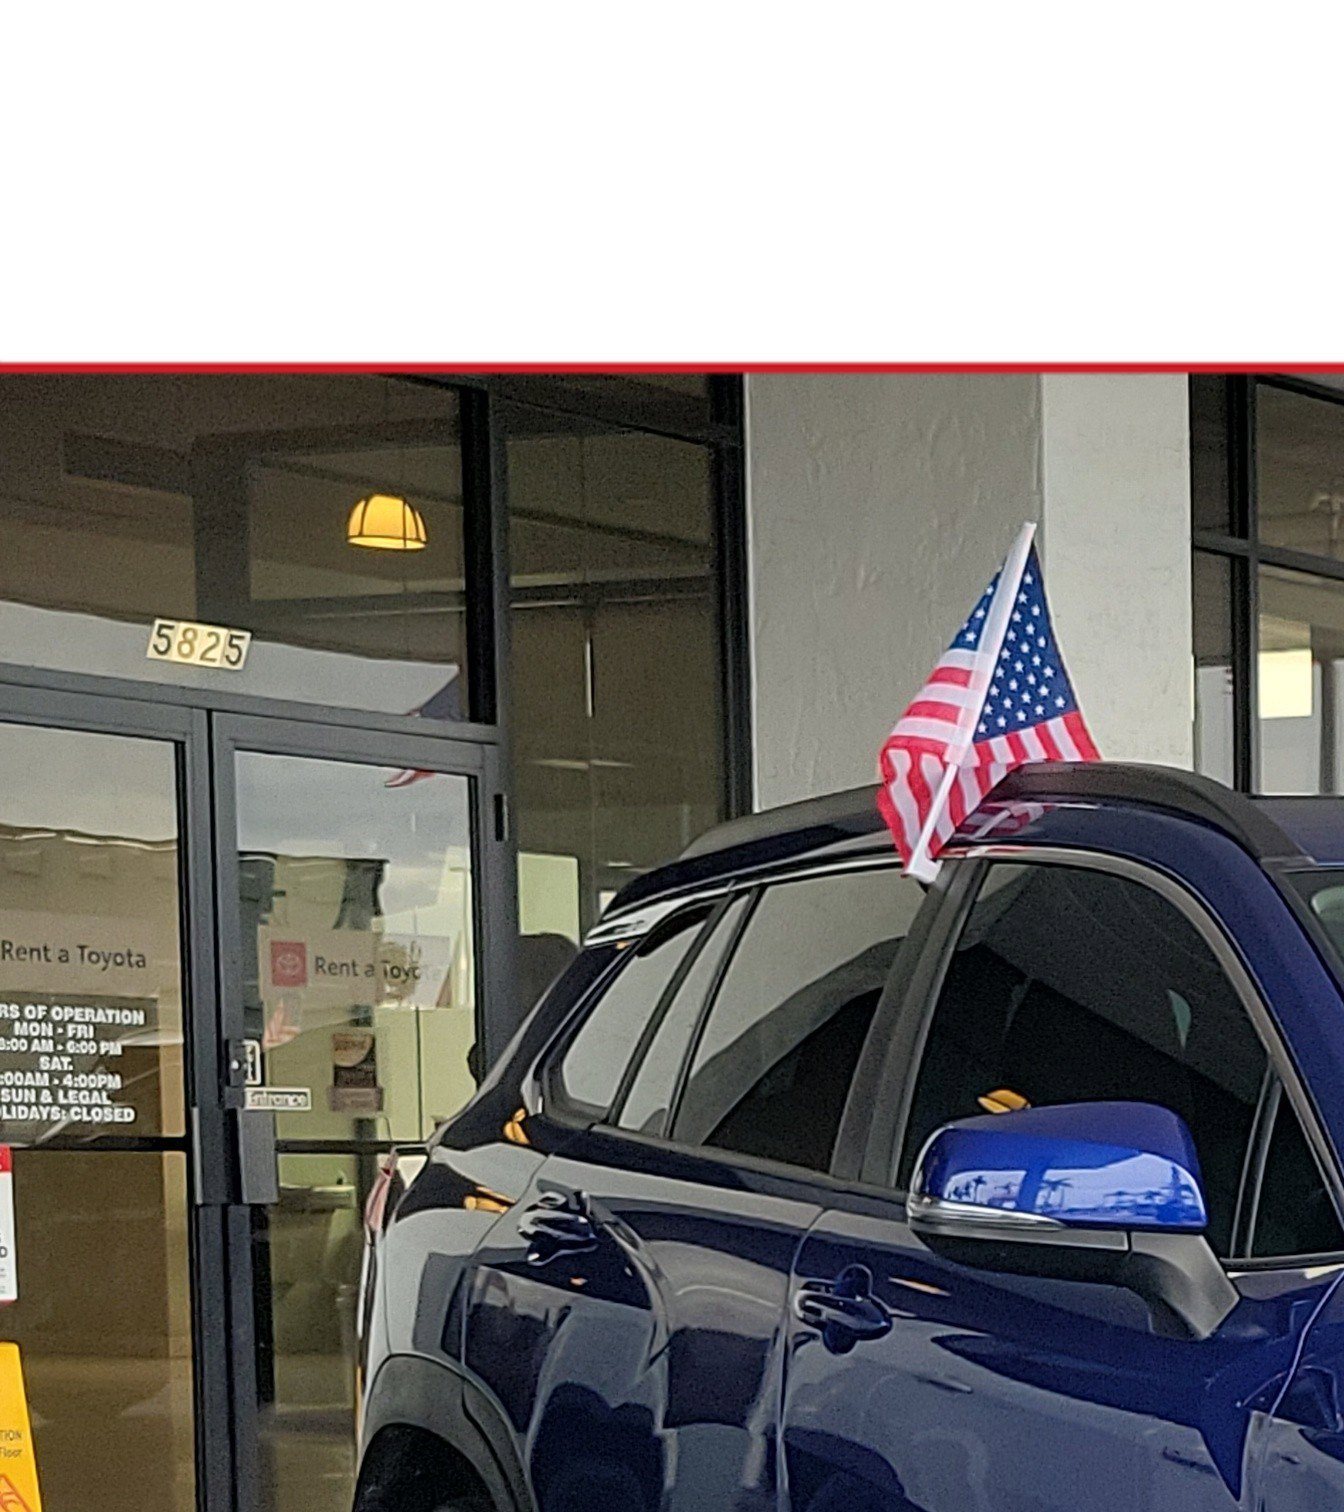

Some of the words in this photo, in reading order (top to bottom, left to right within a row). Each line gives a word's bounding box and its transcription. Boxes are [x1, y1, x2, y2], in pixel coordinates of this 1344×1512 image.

[153, 624, 245, 666] 5825
[1, 940, 52, 963] Rent
[58, 948, 70, 964] a
[76, 945, 147, 971] Toyota
[314, 956, 359, 977] Rent
[364, 963, 375, 977] a
[24, 1004, 48, 1019] OF
[51, 1005, 145, 1025] OPERATION
[14, 1020, 54, 1037] MON
[67, 1023, 95, 1039] FRI
[31, 1038, 54, 1053] AM
[66, 1040, 97, 1055] 6:00
[99, 1041, 122, 1056] PM
[39, 1055, 73, 1071] SAT.
[63, 1073, 122, 1089] 4:00PM
[1, 1087, 36, 1104] SUN
[40, 1088, 53, 1104] &
[58, 1088, 112, 1105] LEGAL
[0, 1104, 67, 1121] LIDAYS:
[70, 1105, 136, 1122] CLOSED
